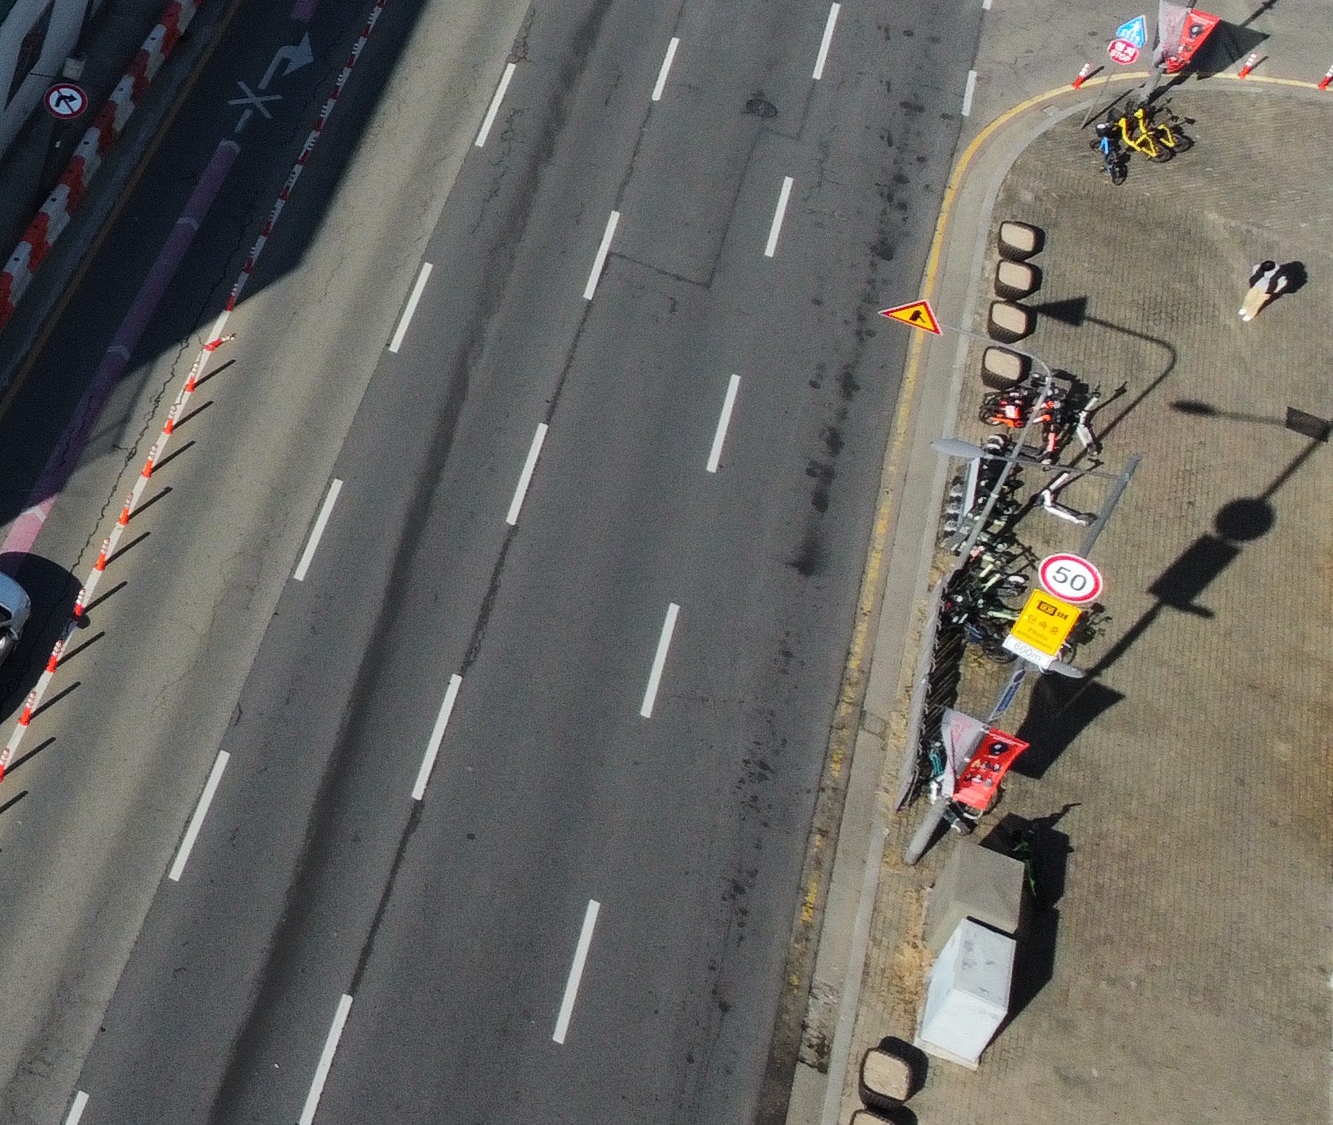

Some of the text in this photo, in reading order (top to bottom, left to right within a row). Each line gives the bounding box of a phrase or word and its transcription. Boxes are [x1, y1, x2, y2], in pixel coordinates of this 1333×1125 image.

[1110, 50, 1132, 62] STOP
[1053, 566, 1087, 592] 50
[1013, 642, 1042, 662] 600m
